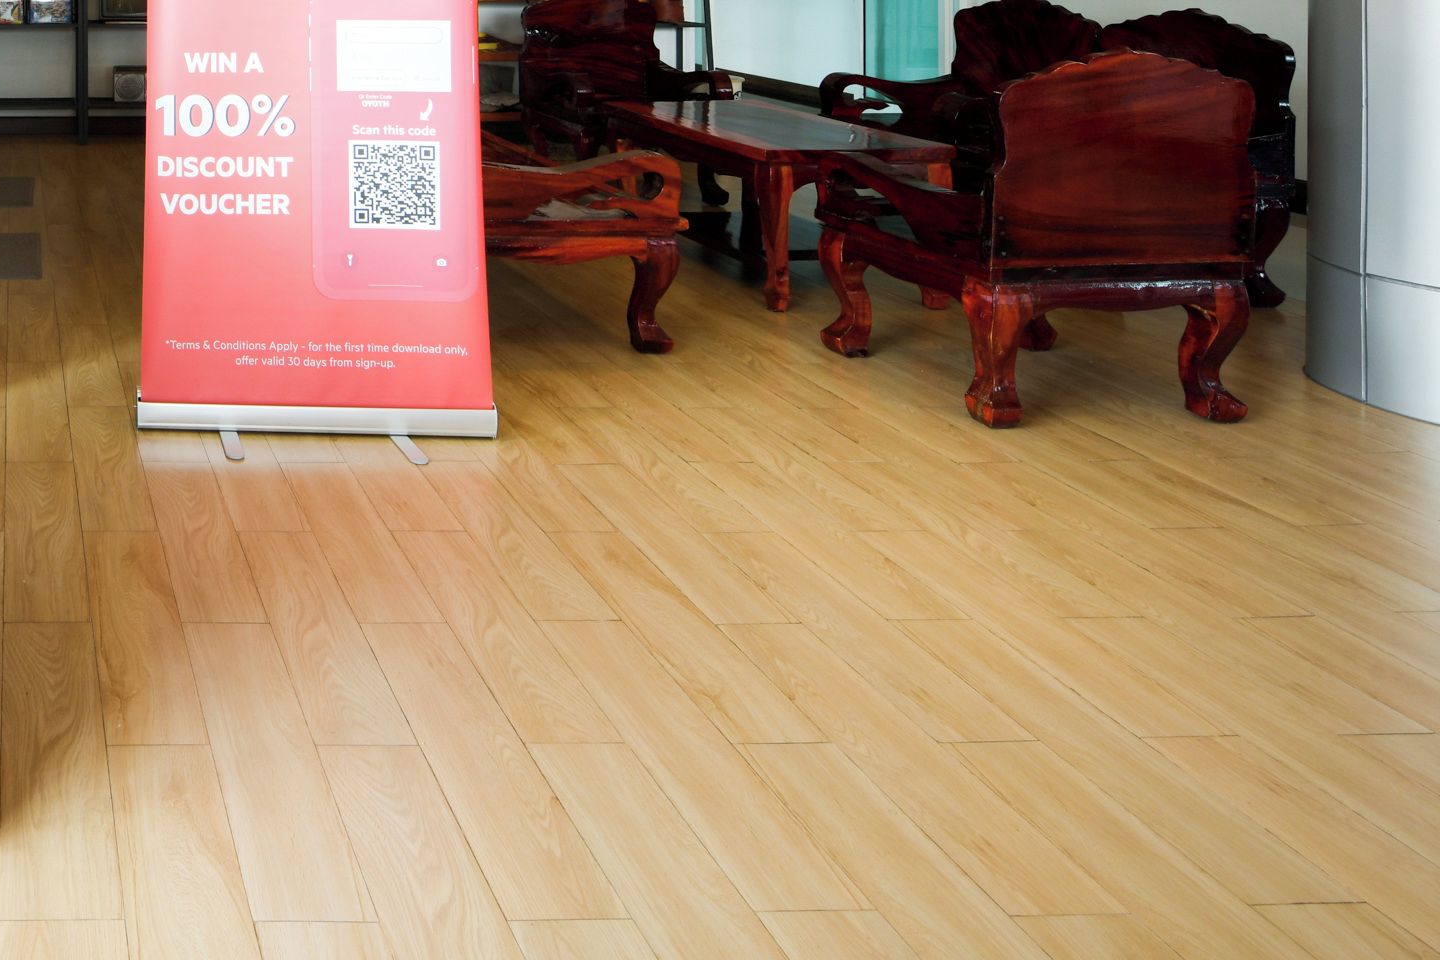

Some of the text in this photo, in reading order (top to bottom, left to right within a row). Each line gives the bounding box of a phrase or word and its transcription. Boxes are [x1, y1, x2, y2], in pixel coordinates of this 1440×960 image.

[184, 52, 264, 74] WIN A
[154, 93, 296, 138] 100%
[352, 124, 437, 136] Scan this code
[157, 155, 294, 178] DISCOUNT
[160, 192, 290, 216] VOUCHER
[202, 340, 210, 350] &
[213, 340, 266, 350] Conditions
[269, 341, 299, 353] Apply
[308, 341, 321, 351] for
[325, 342, 342, 352] the
[344, 342, 364, 352] first
[367, 342, 389, 352] time
[391, 343, 442, 354] download
[444, 345, 468, 357] only,
[235, 355, 396, 370] offer valid 30 days from sign-up.
